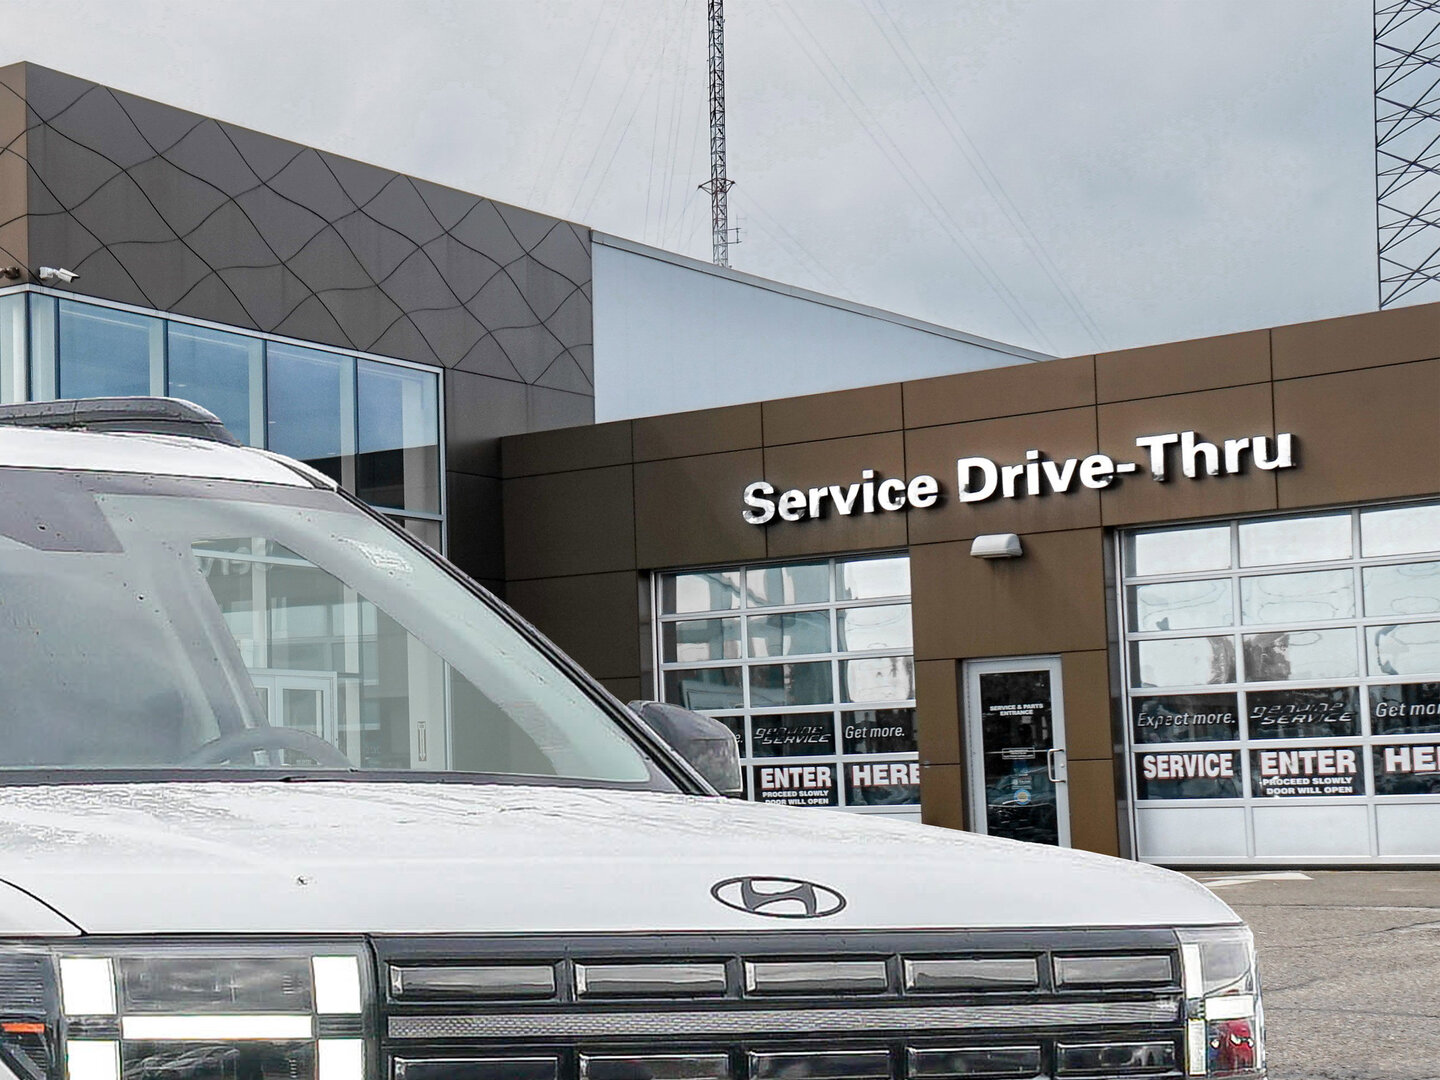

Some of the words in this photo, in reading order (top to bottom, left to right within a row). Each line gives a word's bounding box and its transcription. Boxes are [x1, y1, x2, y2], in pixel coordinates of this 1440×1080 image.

[742, 469, 939, 525] Service
[957, 431, 1294, 503] Drive-Thru
[1375, 702, 1406, 718] Get
[1137, 711, 1189, 729] Expect
[1192, 712, 1236, 726] more.
[1260, 711, 1353, 725] SERVICE
[761, 733, 832, 745] SERVICE
[845, 725, 868, 739] Get
[869, 726, 906, 738] more.
[1143, 753, 1234, 779] SERVICE
[1259, 749, 1357, 776] ENTER
[761, 766, 832, 790] ENTER
[1262, 778, 1310, 786] PROCEED
[1312, 777, 1353, 785] SLOWLY
[762, 790, 798, 798] PROCEED
[798, 789, 829, 797] SLOWLY
[1266, 787, 1296, 795] DOOR
[1297, 786, 1322, 794] WILL
[1323, 786, 1353, 794] OPEN
